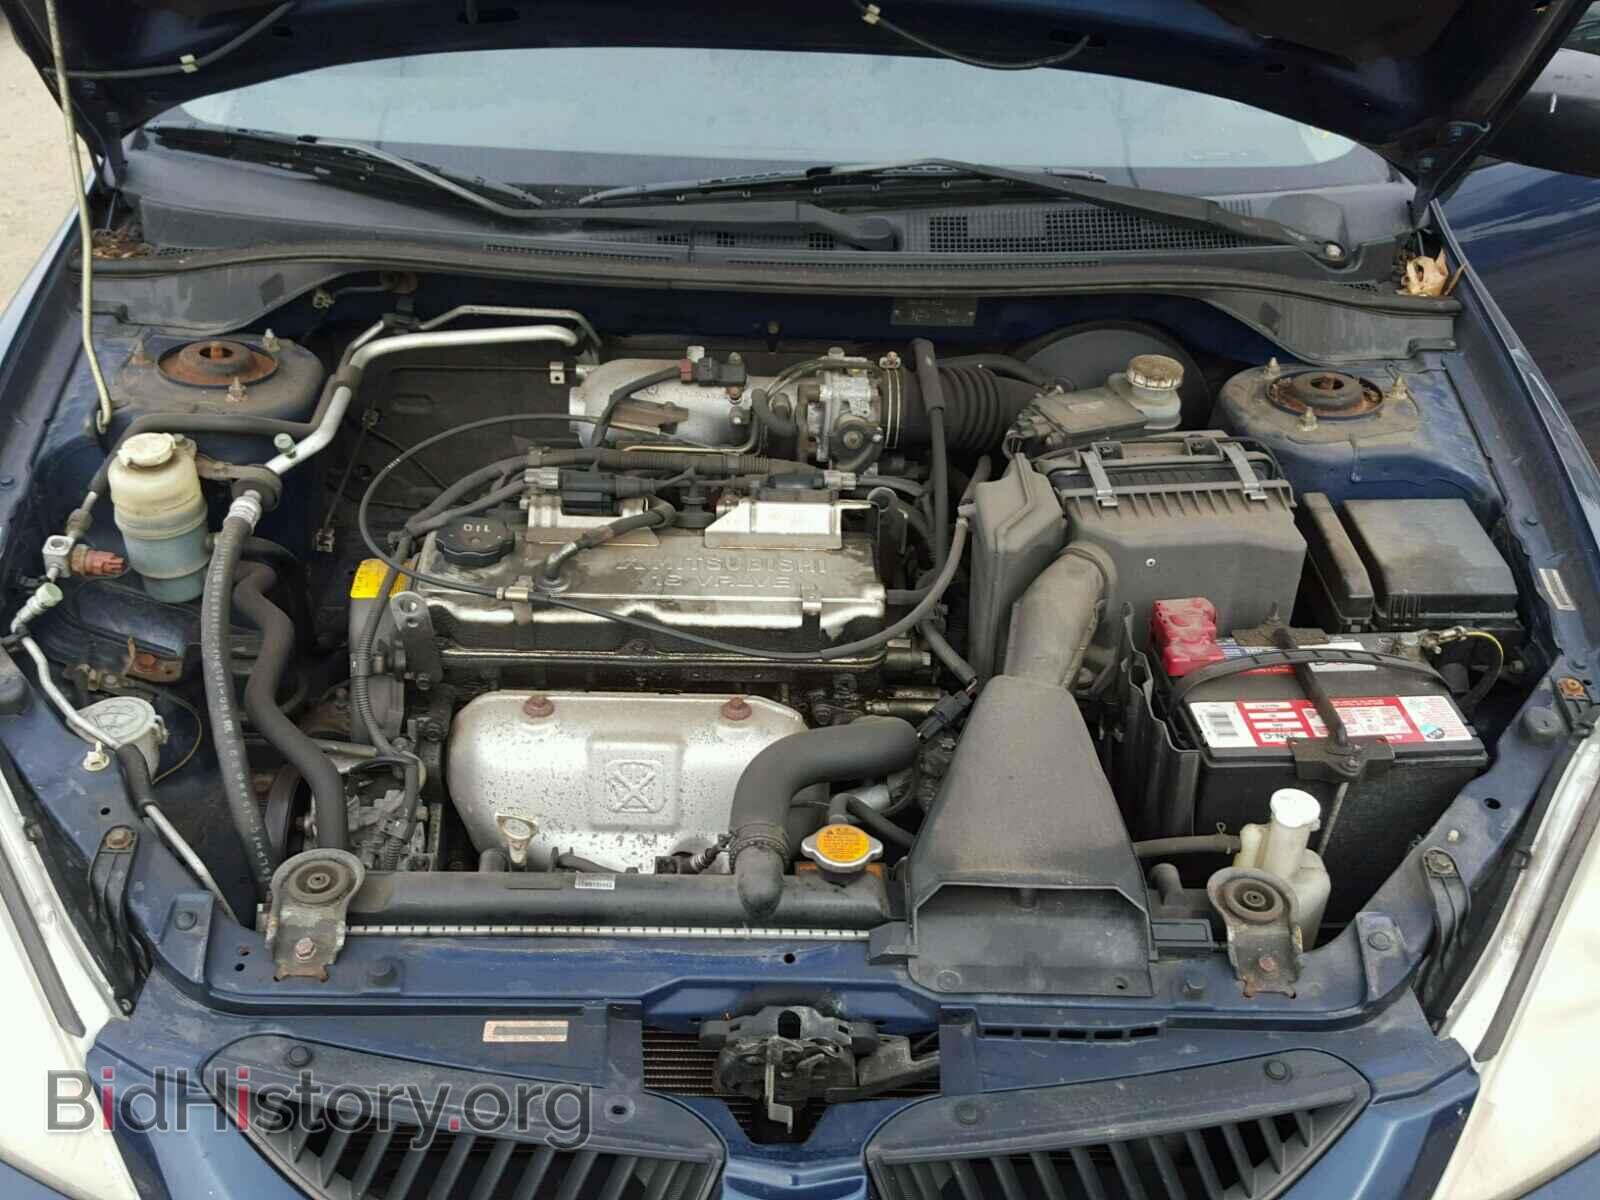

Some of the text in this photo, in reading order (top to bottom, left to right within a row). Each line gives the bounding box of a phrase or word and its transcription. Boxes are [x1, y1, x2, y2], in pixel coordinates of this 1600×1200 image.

[462, 522, 492, 534] OIL
[646, 555, 828, 574] MITSUBISHI
[694, 574, 795, 589] VALVE
